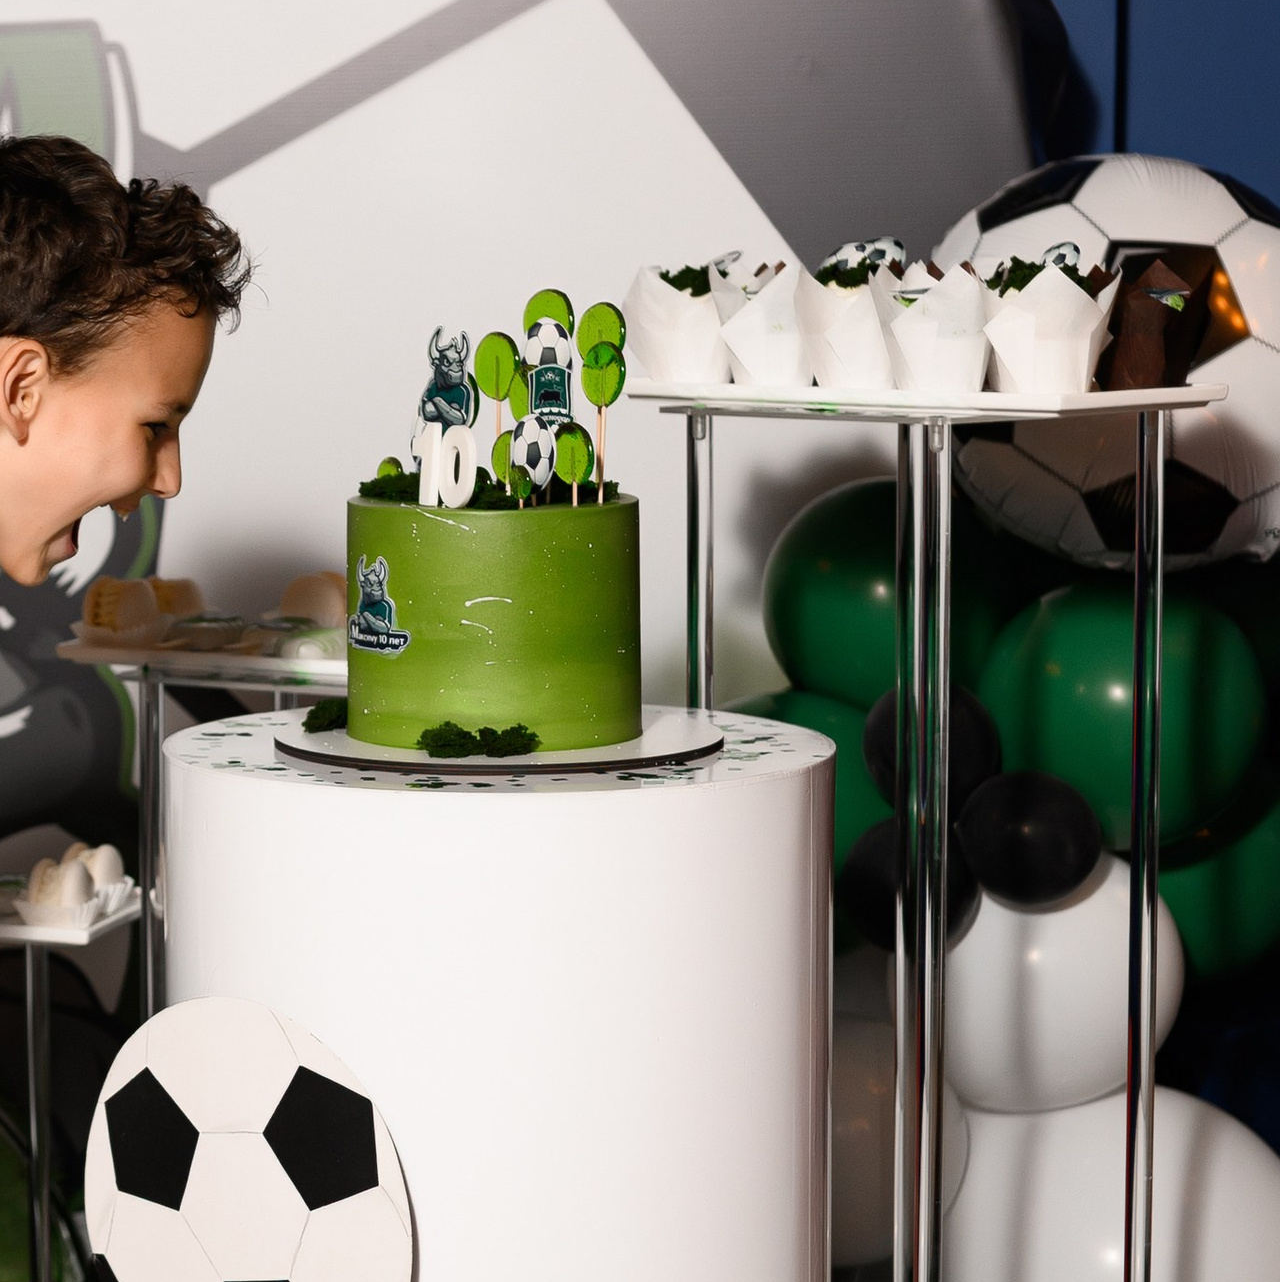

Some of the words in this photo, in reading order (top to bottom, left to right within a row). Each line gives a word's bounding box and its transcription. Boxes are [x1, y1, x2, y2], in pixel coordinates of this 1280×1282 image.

[412, 421, 477, 509] 10
[379, 634, 387, 645] 10
[388, 637, 405, 646] лет
